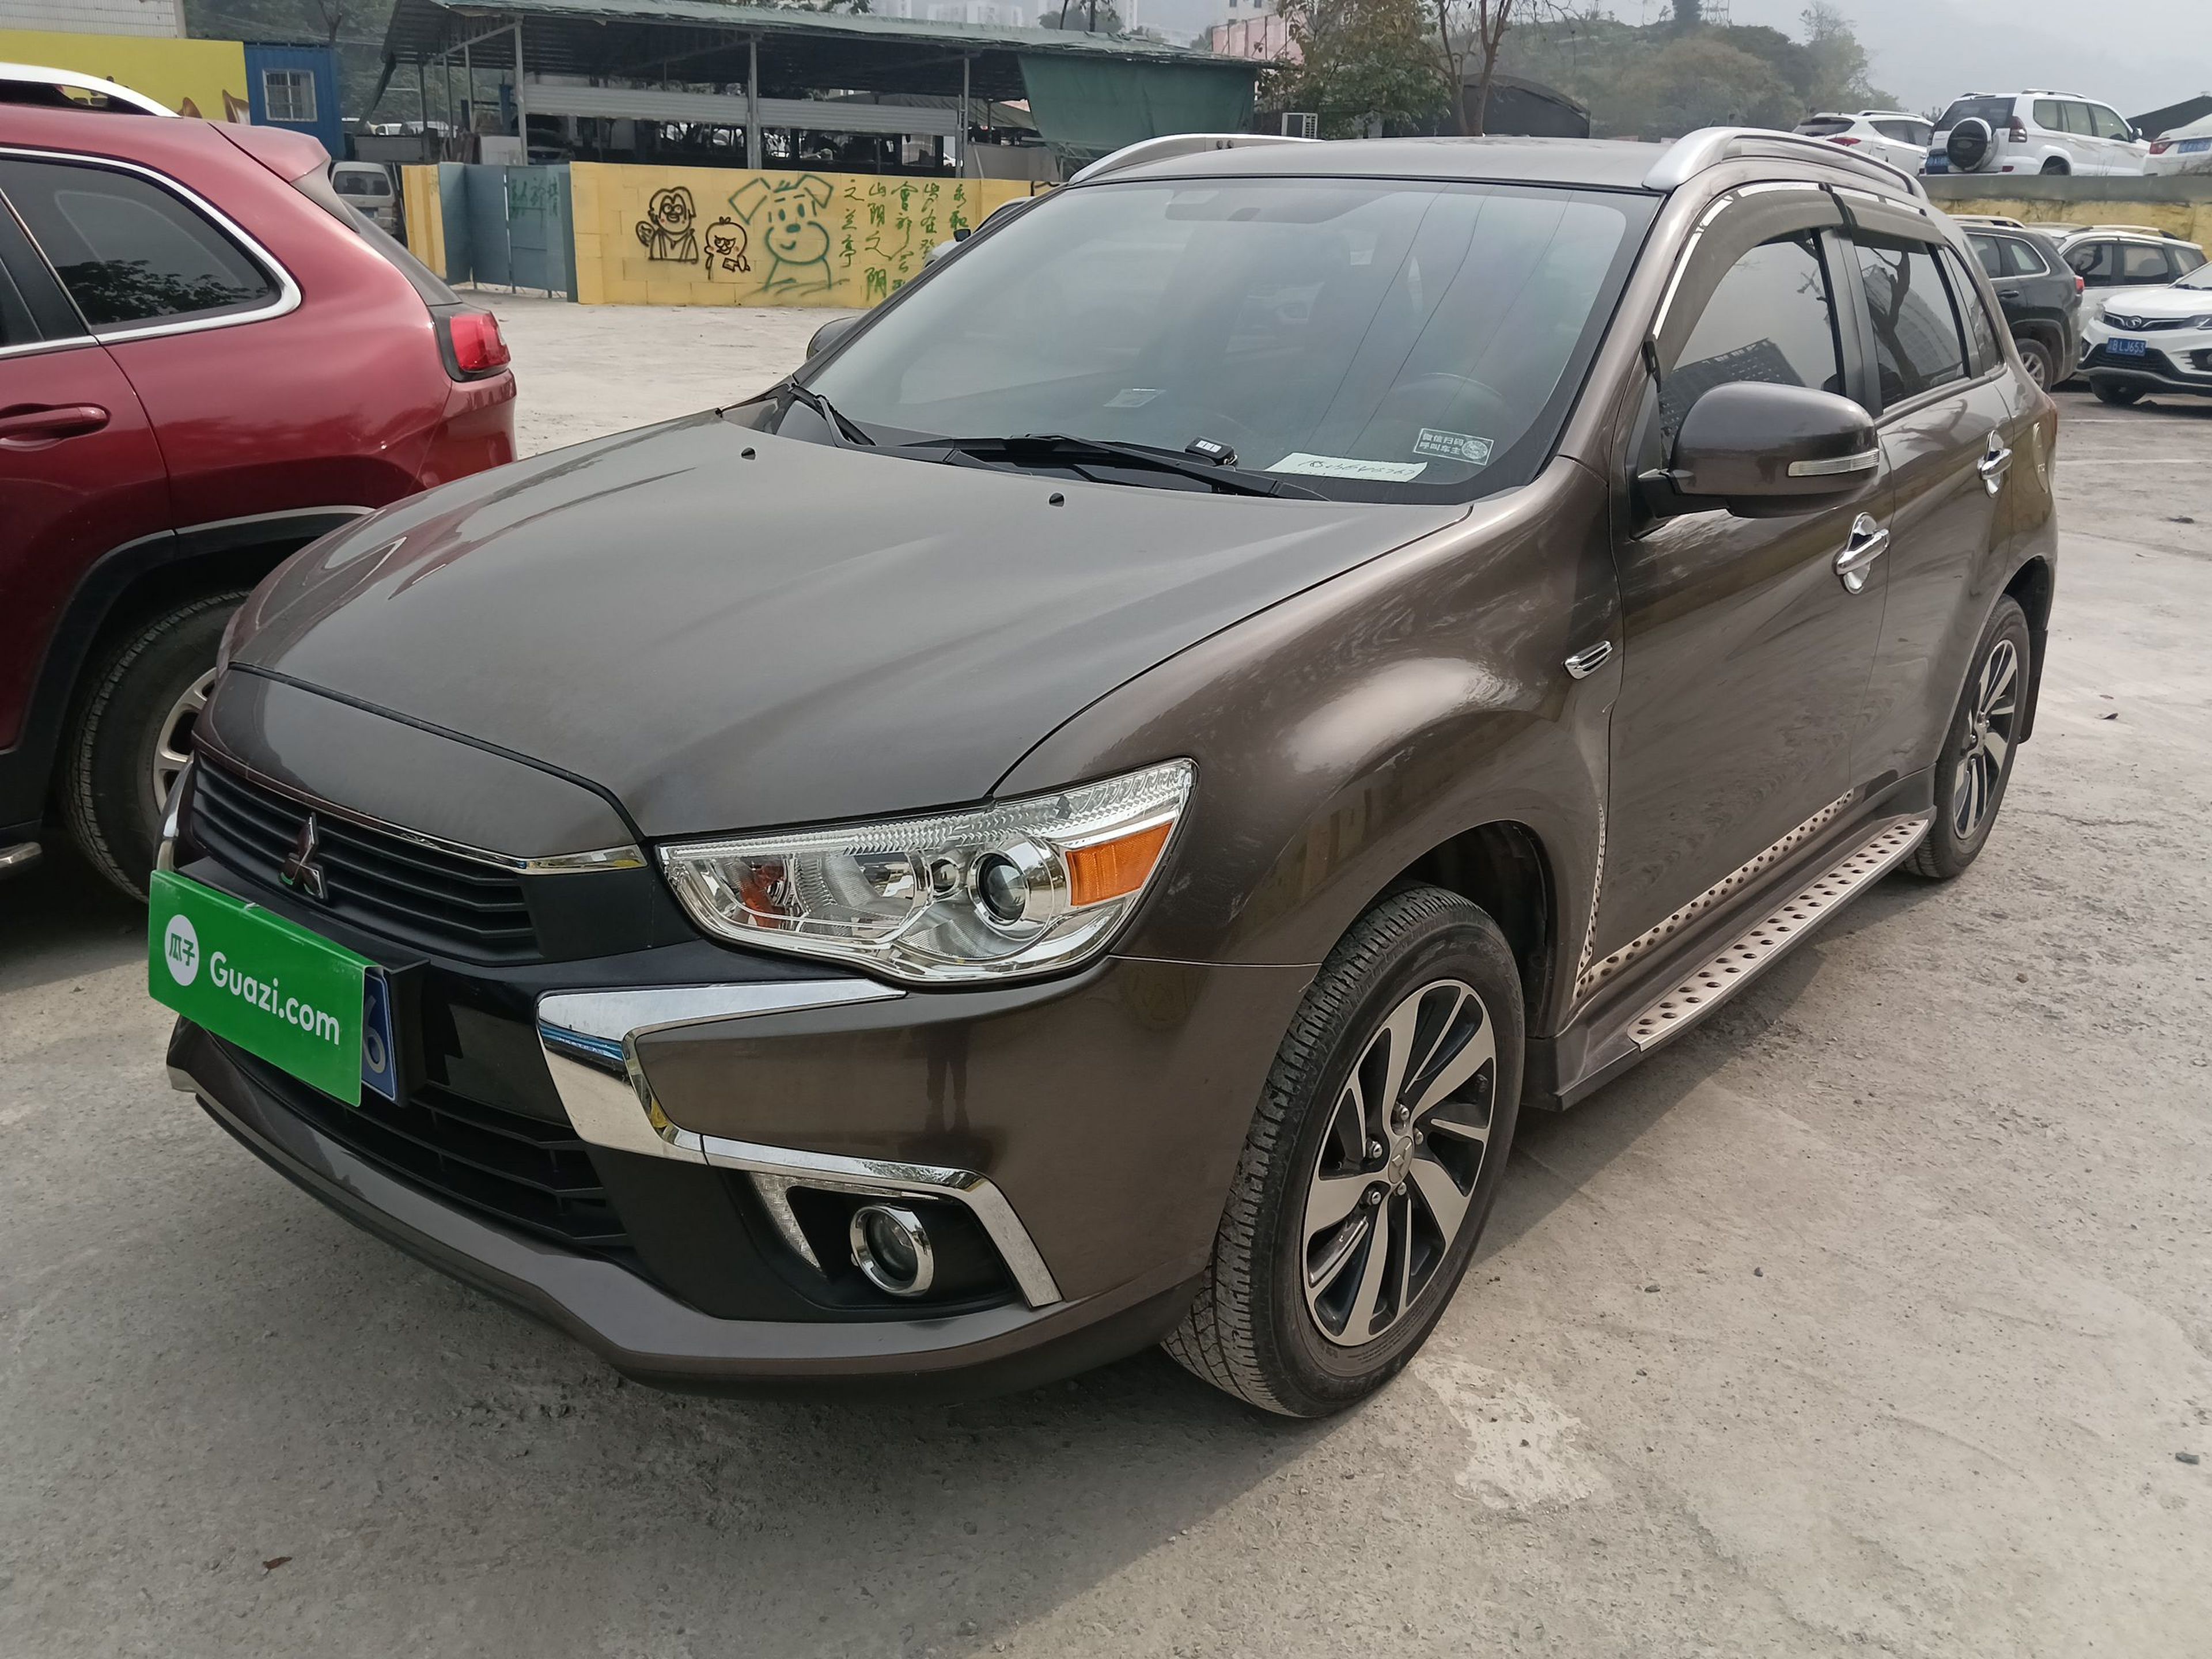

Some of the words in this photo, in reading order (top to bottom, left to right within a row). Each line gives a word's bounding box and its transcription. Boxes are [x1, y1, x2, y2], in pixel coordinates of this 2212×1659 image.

[2108, 339, 2145, 353] BLJ653
[1419, 442, 1461, 454] 呼叫车主
[1422, 433, 1465, 446] 微信扫码
[169, 933, 195, 967] 瓜子
[210, 951, 340, 1046] Guazi.com
[362, 995, 386, 1074] 6
